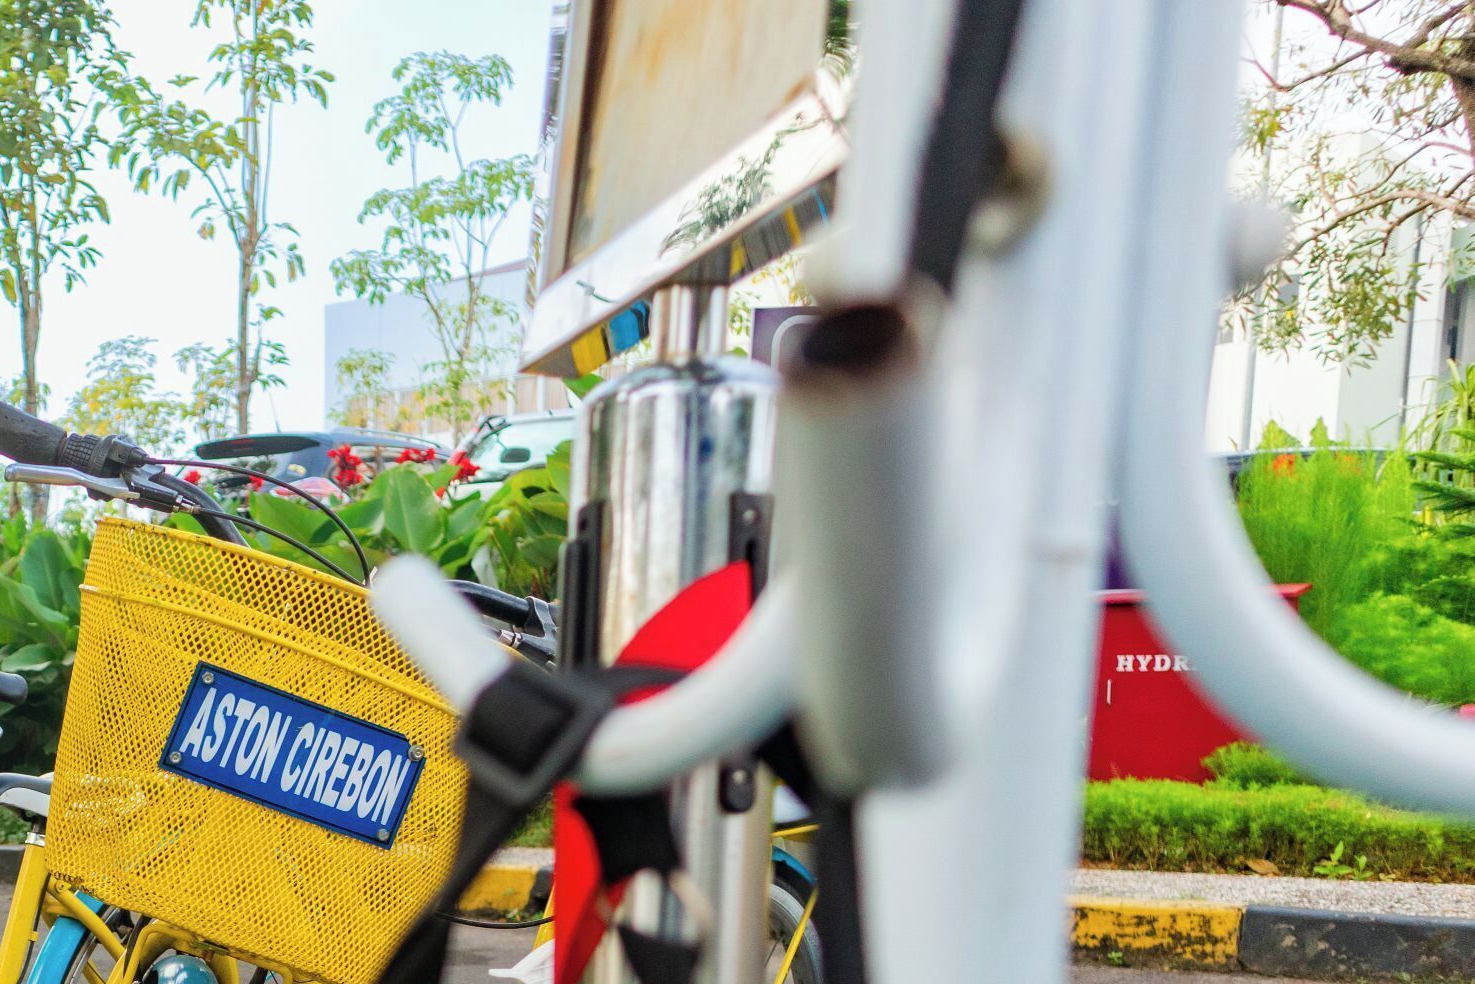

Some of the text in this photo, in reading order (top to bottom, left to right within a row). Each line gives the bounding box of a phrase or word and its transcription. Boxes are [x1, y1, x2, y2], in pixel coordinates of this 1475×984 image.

[1116, 654, 1196, 672] HYDR
[178, 687, 411, 826] ASTON CIREBON
